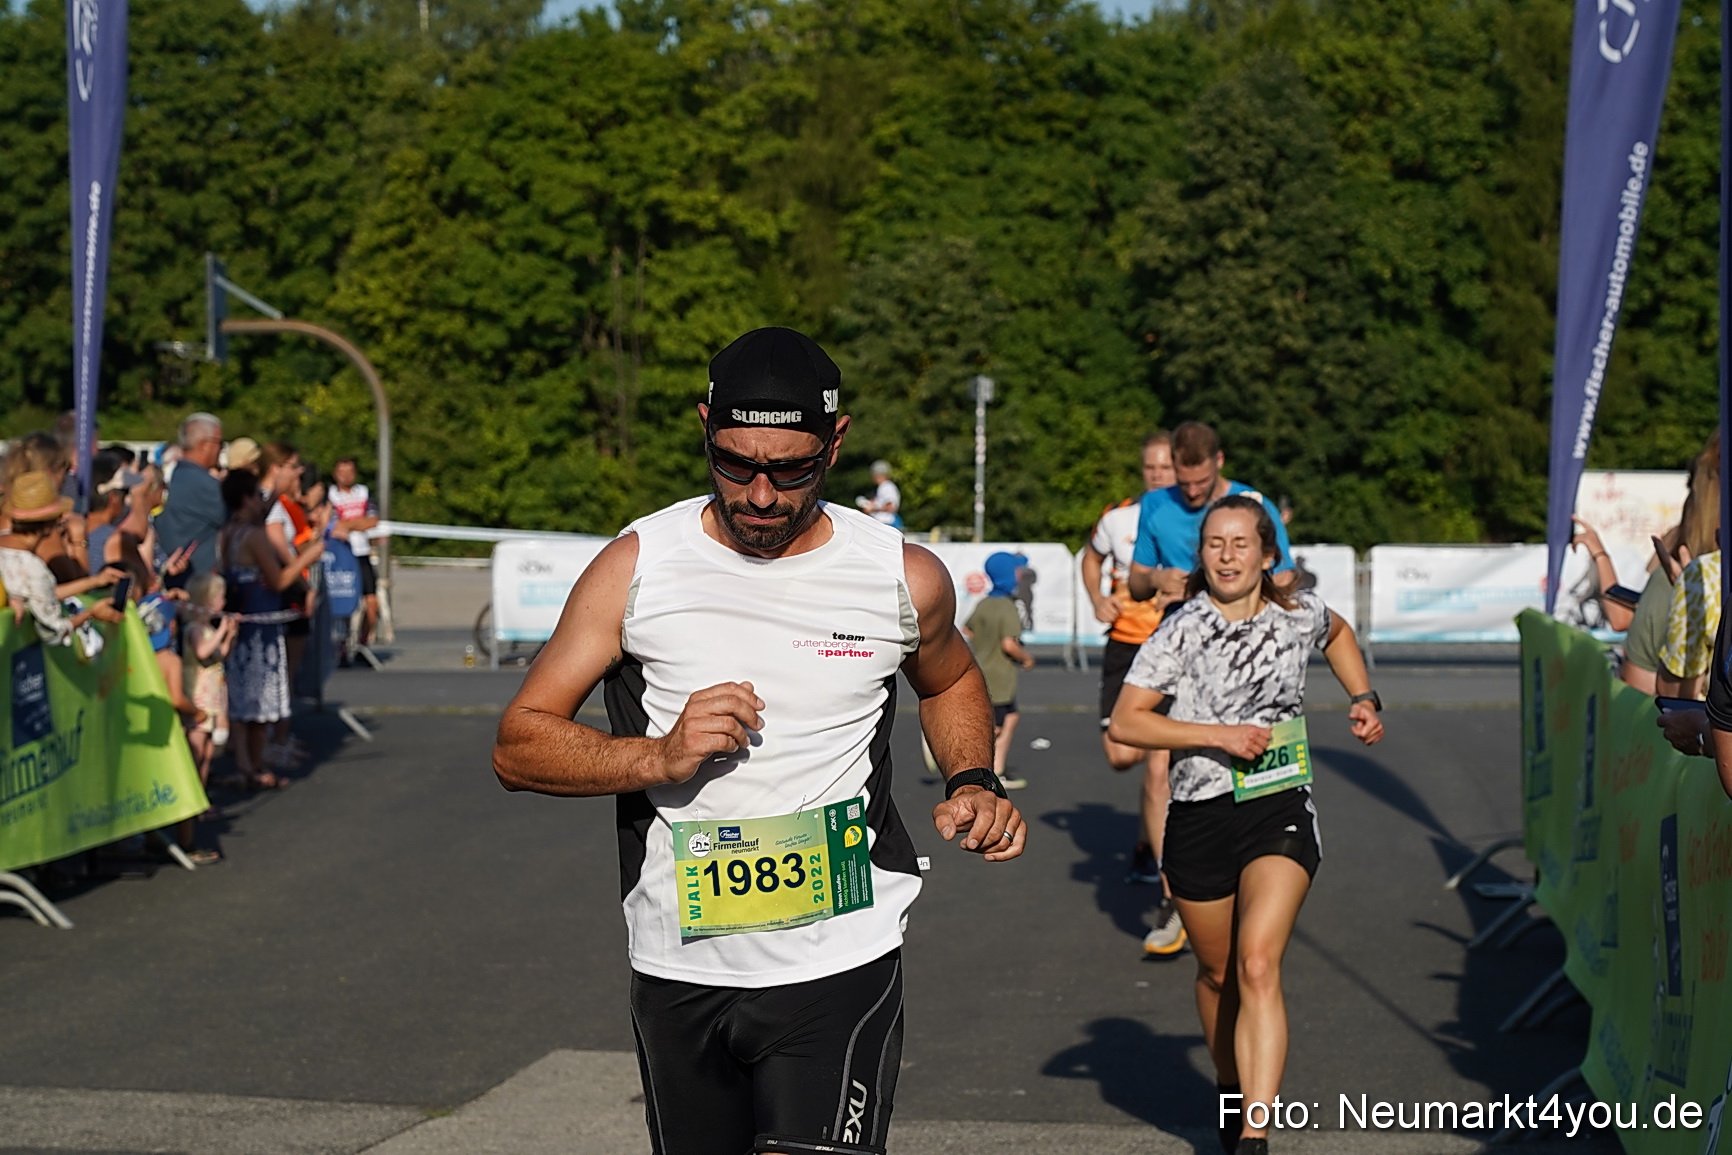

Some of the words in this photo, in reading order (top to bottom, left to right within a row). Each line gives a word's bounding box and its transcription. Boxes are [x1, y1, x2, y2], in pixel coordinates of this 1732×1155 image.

[832, 632, 865, 641] team
[792, 640, 857, 650] guttenberger
[713, 838, 760, 850] Firmenlauf
[731, 846, 760, 854] neumarkt
[703, 853, 806, 897] 1983
[810, 853, 825, 904] 2022
[685, 866, 702, 920] WALK
